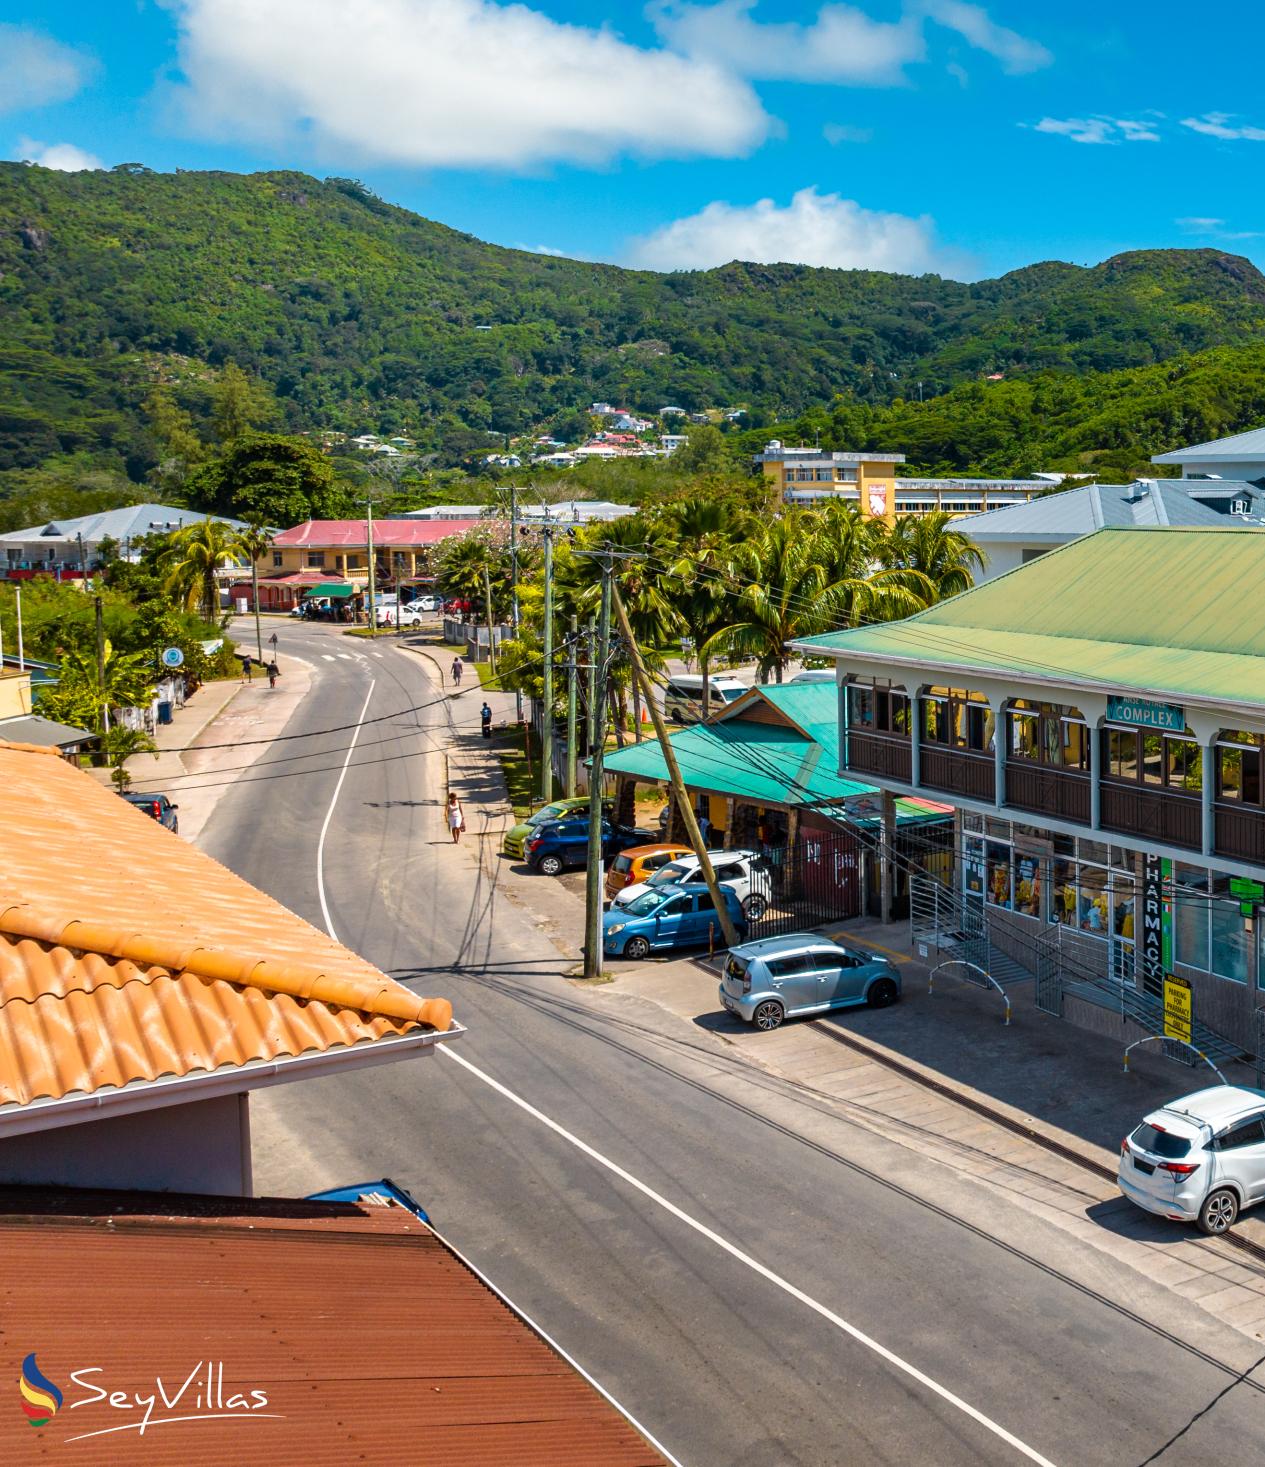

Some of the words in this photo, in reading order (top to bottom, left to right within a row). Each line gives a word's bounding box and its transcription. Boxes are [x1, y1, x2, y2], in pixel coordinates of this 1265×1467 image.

[1115, 705, 1174, 726] COMPLEX
[1145, 853, 1160, 976] PHARMACY
[1173, 997, 1183, 1007] FOR
